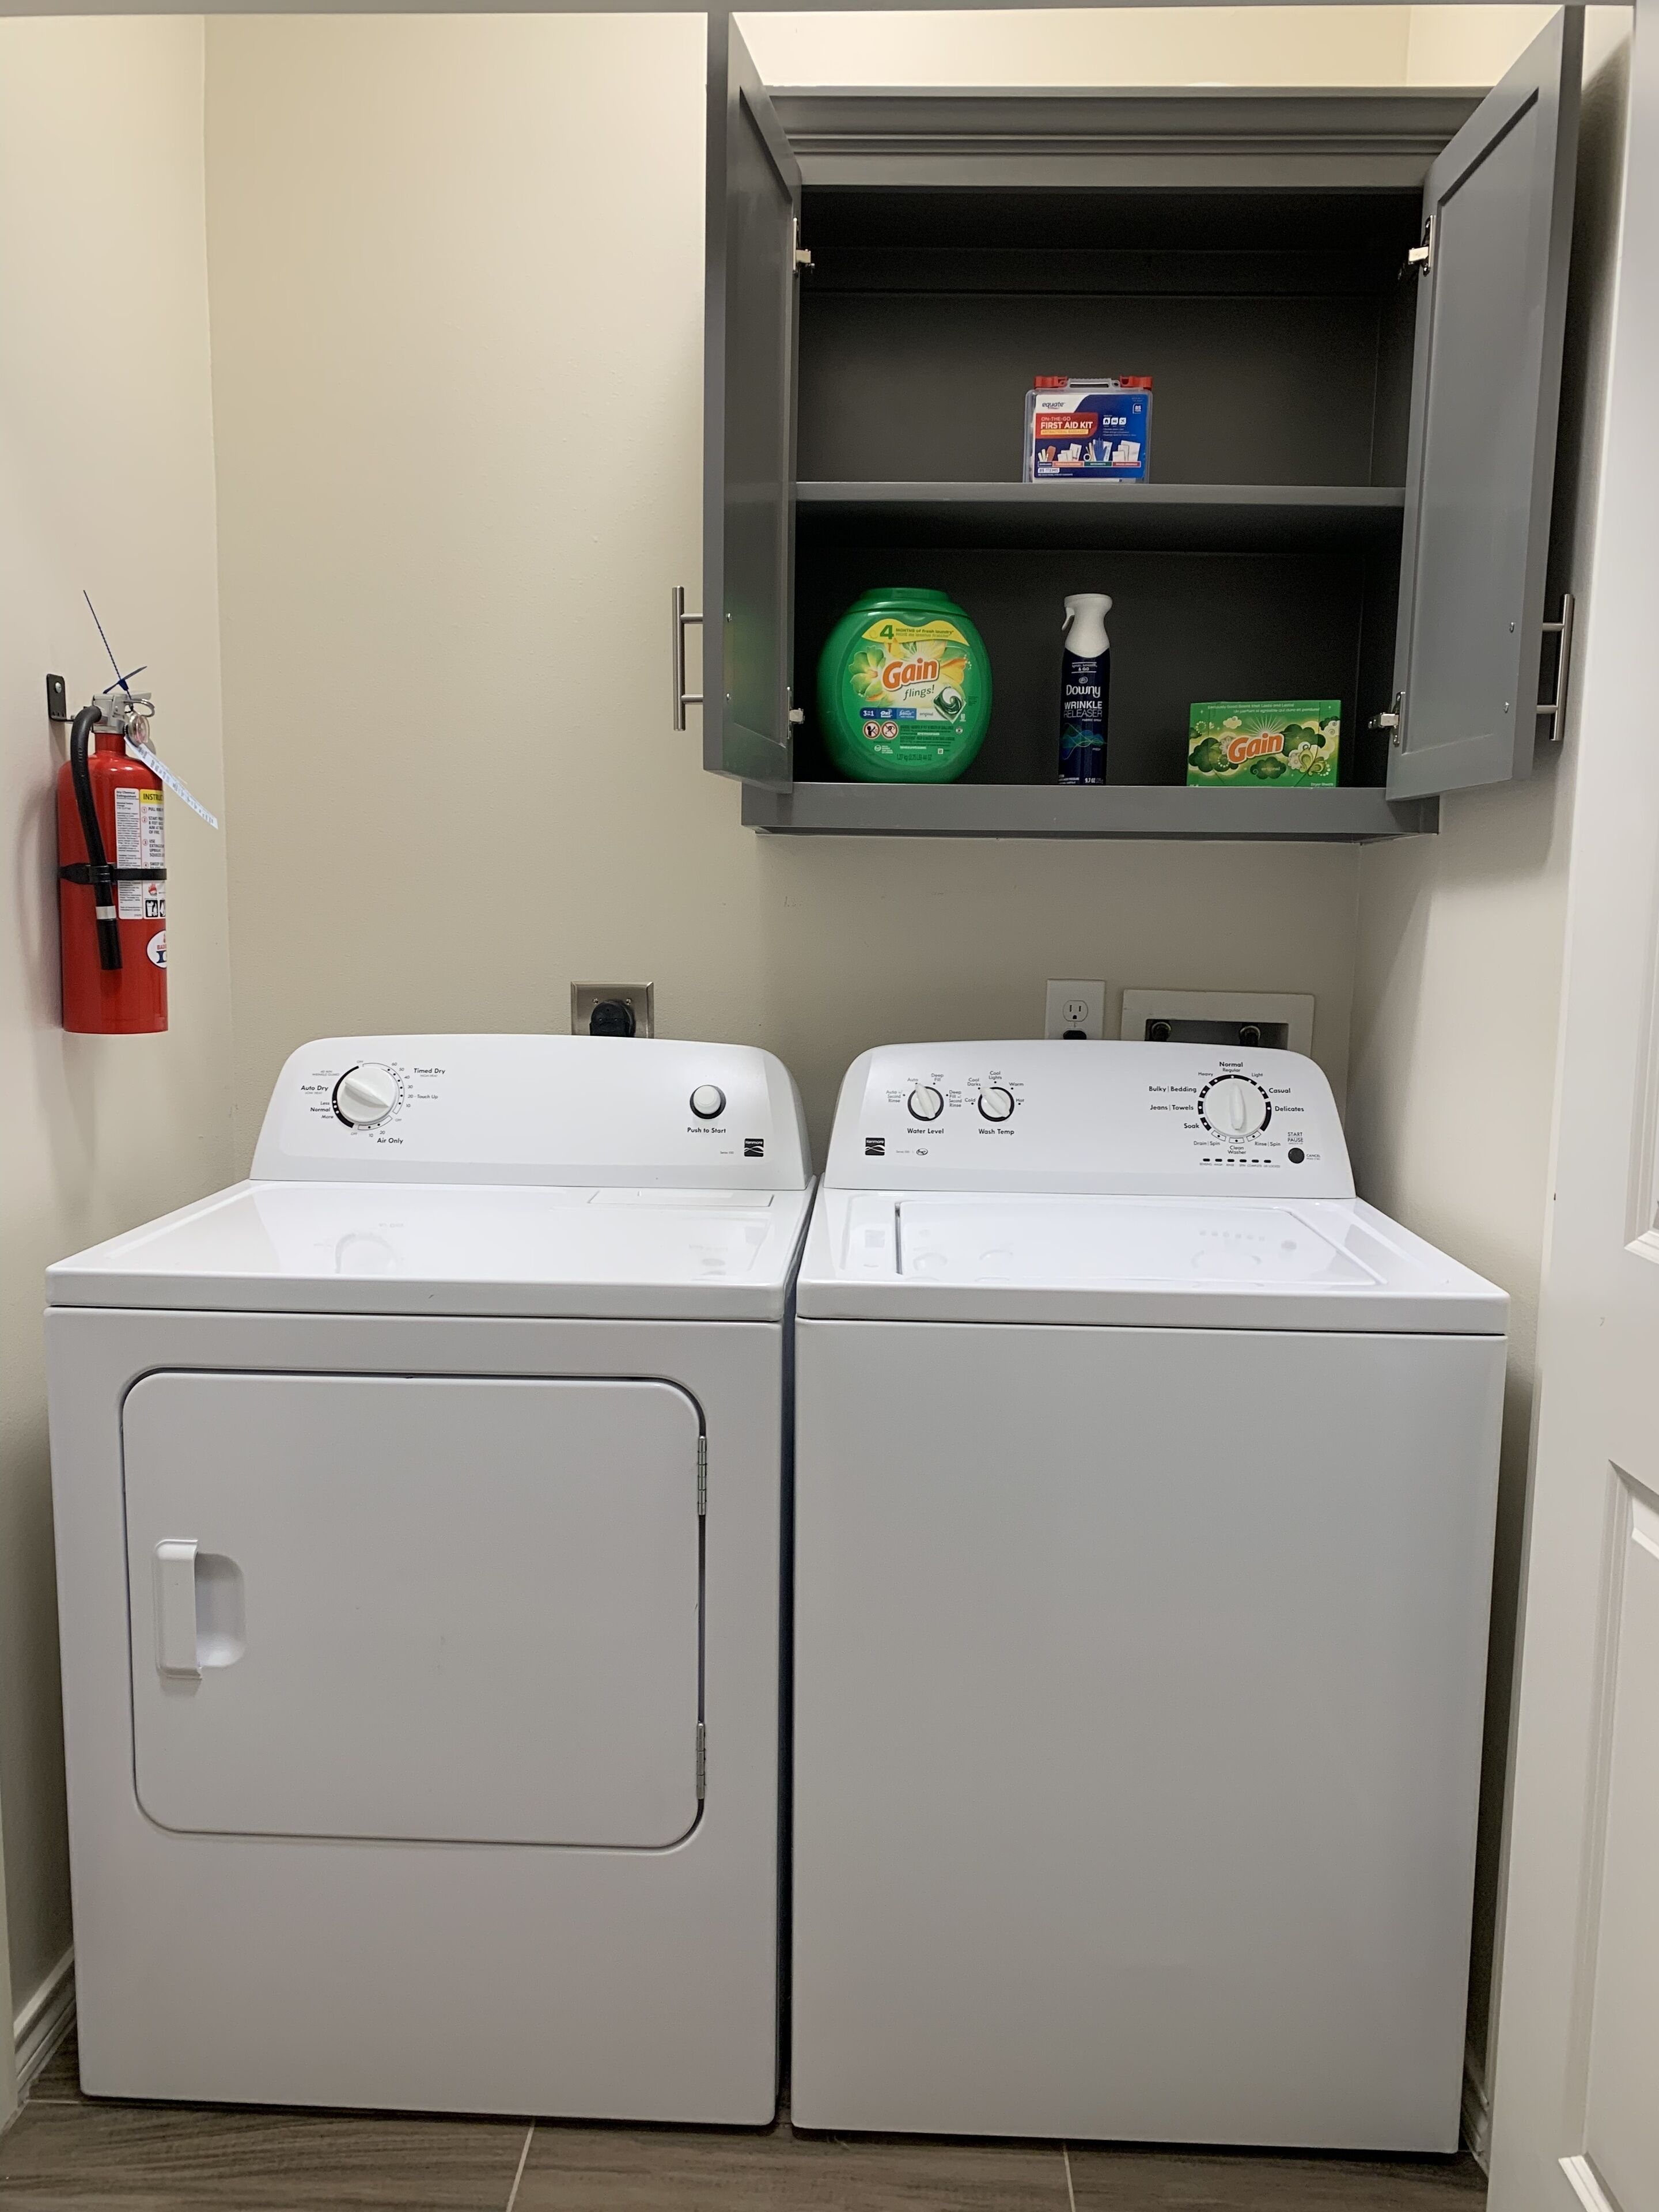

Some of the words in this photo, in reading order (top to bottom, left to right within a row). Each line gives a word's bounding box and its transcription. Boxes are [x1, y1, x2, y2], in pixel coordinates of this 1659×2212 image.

[880, 625, 894, 639] 4
[882, 658, 938, 689] Gain
[903, 684, 935, 700] flings!
[1066, 684, 1101, 698] Downy
[1065, 700, 1103, 710] WRINKLE
[1063, 709, 1103, 718] RELEASER
[1228, 732, 1283, 762] Gain
